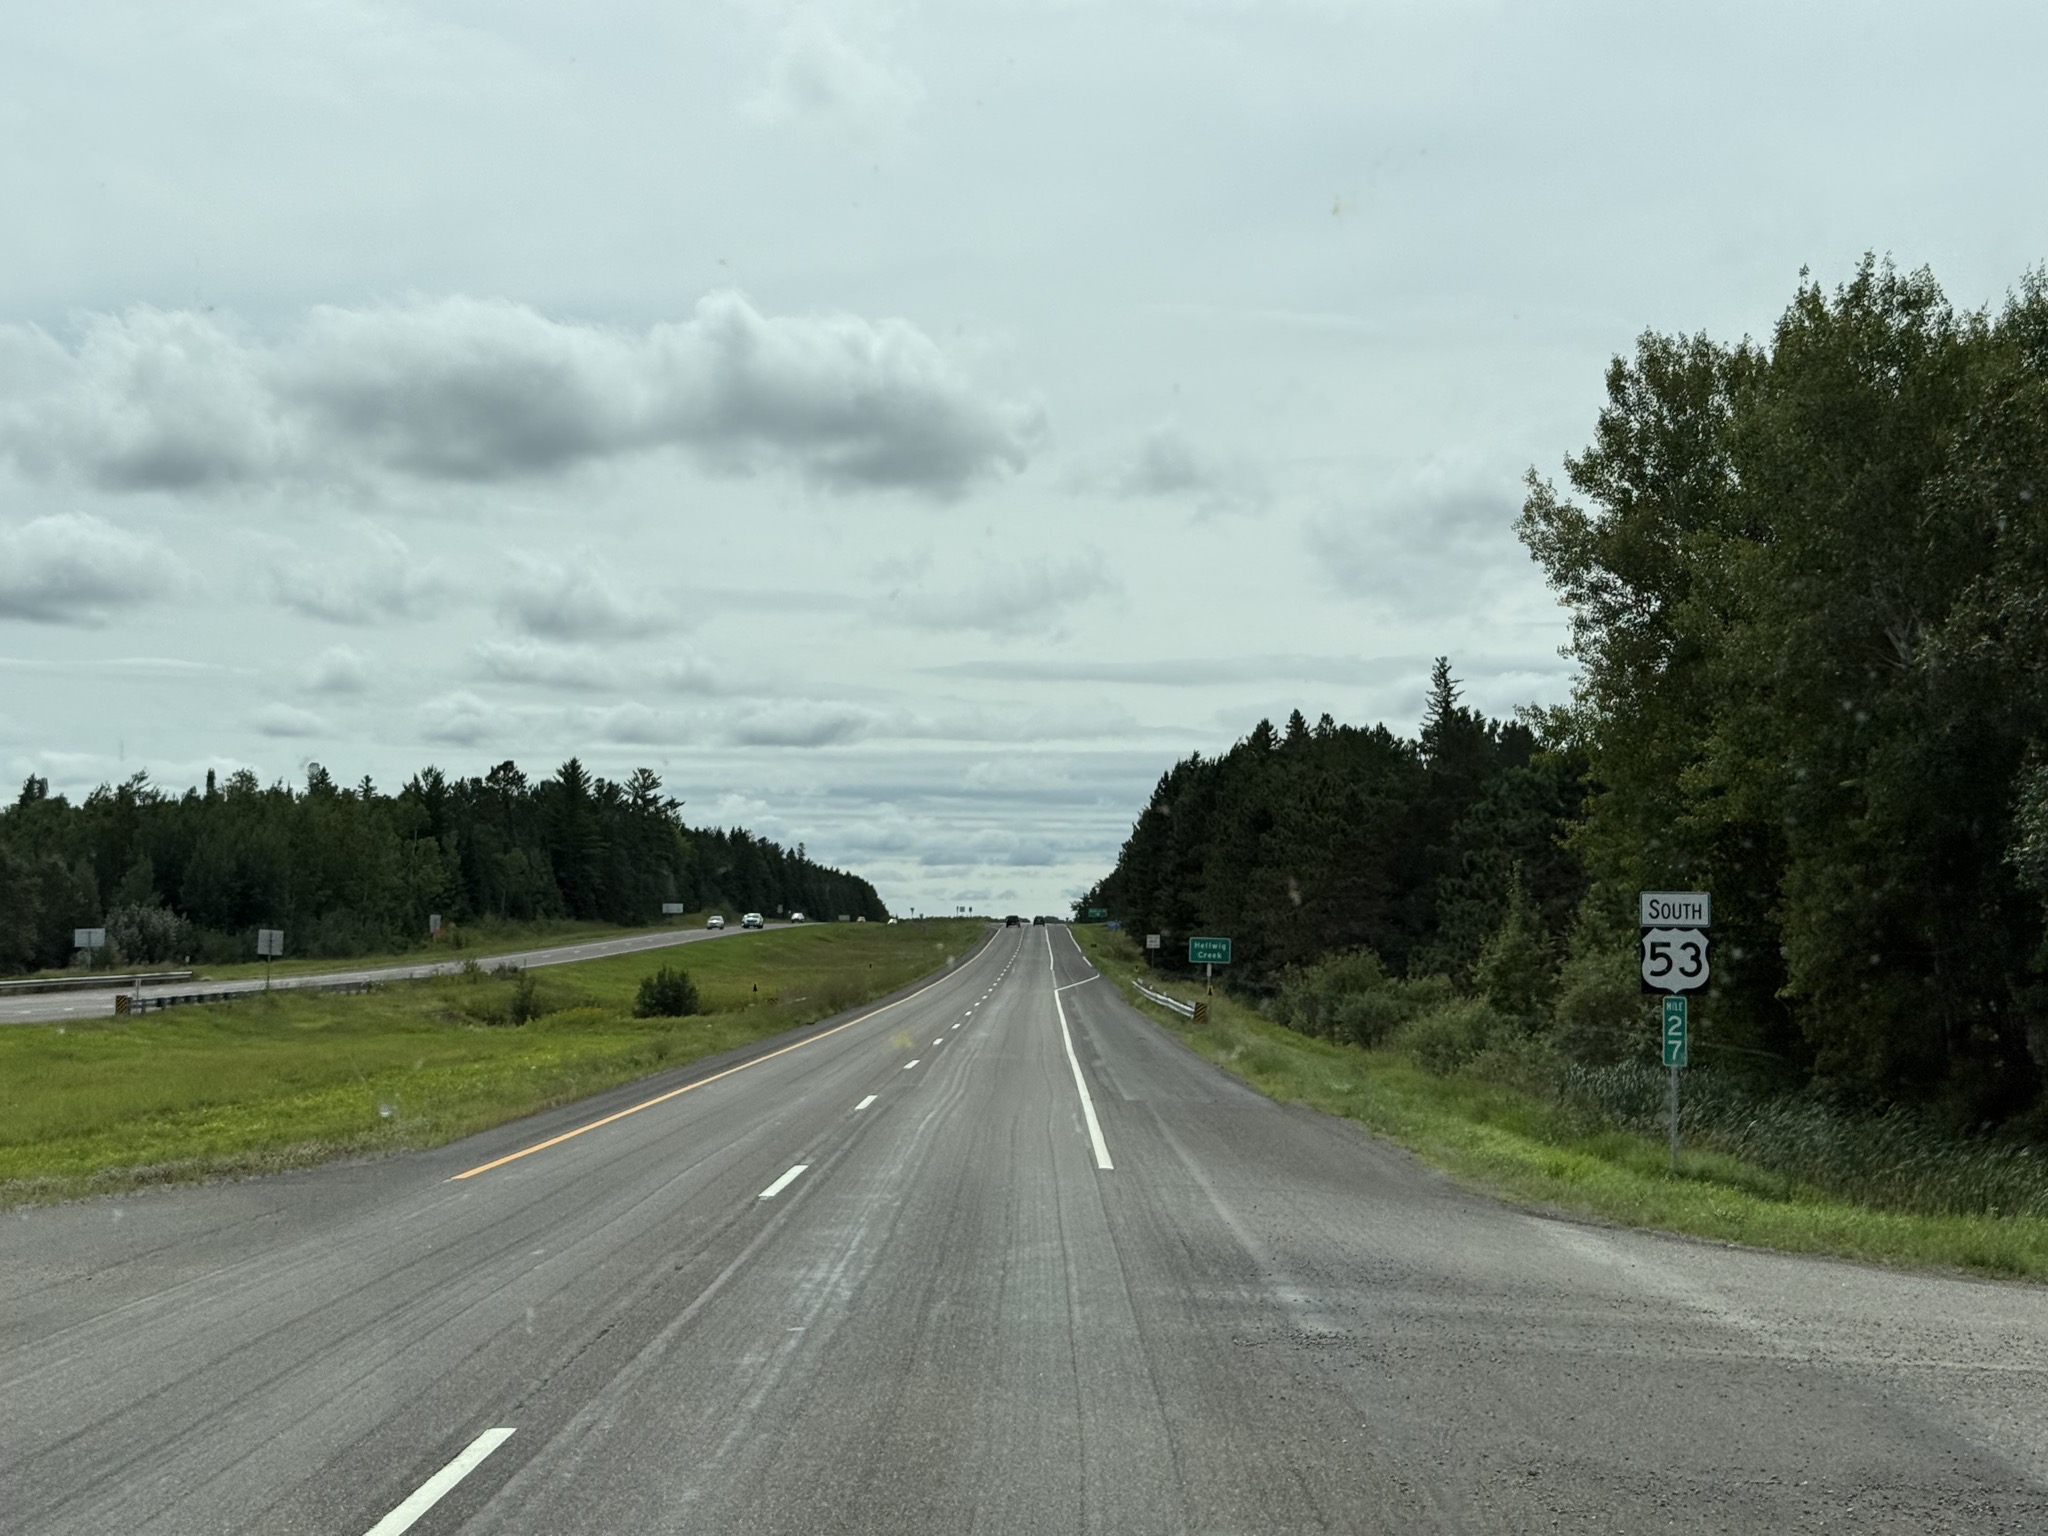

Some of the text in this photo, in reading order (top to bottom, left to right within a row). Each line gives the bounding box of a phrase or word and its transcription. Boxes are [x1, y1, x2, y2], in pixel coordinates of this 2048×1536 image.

[1648, 899, 1702, 920] SOUTH
[1197, 951, 1222, 959] Creek
[1649, 941, 1703, 978] 53
[1666, 1002, 1683, 1011] MILE
